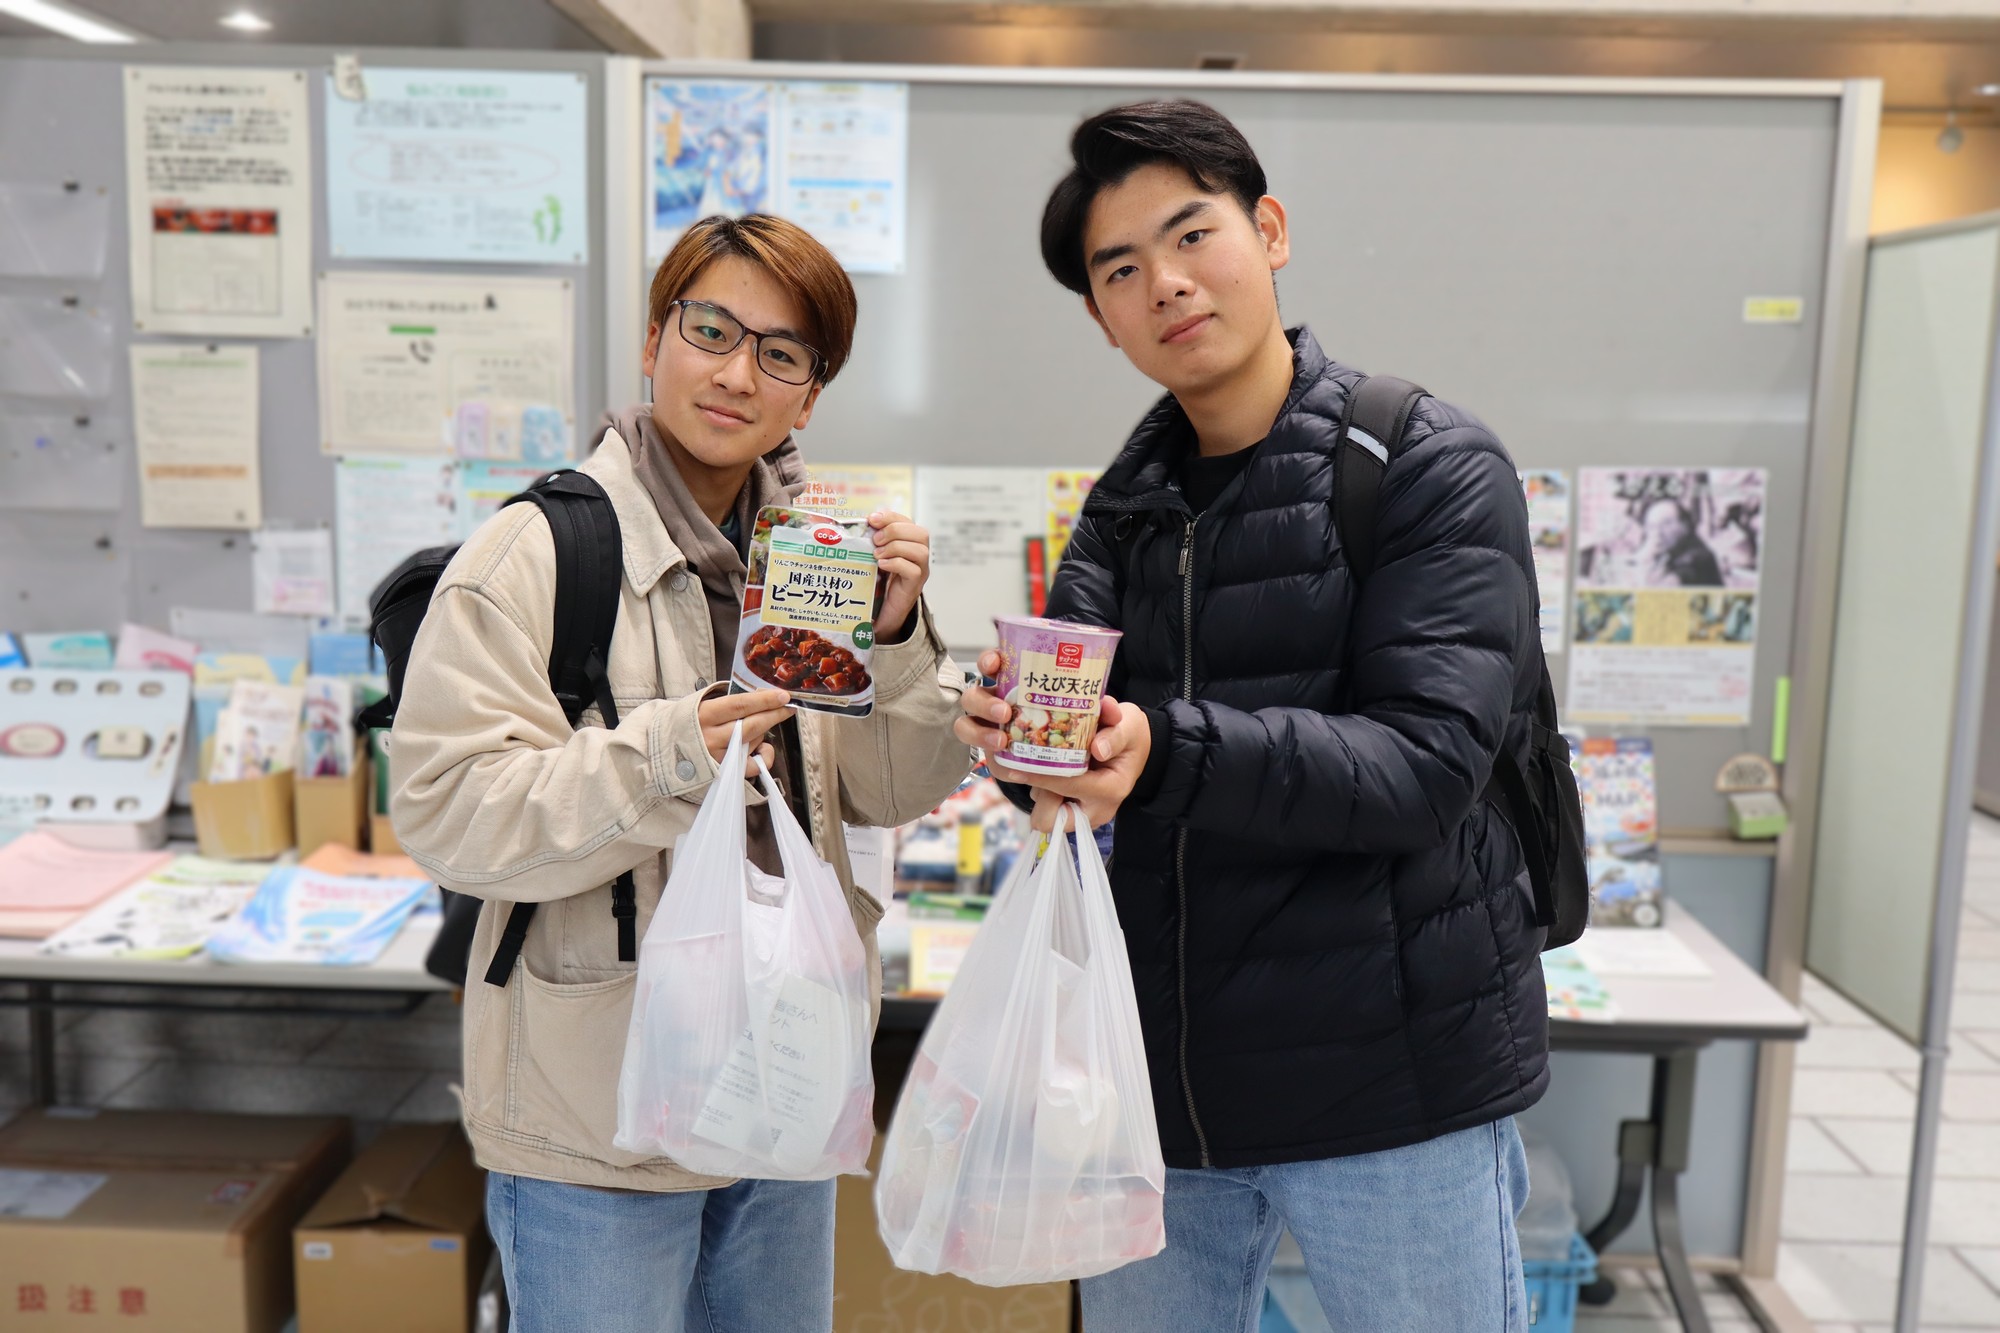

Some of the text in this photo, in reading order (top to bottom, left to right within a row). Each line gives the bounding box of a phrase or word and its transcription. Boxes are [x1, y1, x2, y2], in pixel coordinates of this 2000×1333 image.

[788, 571, 853, 590] 国産具材の
[772, 584, 866, 609] ビーフカレー
[1023, 671, 1102, 696] 小えび天そば
[1033, 694, 1089, 709] あおさ揚げ玉入り
